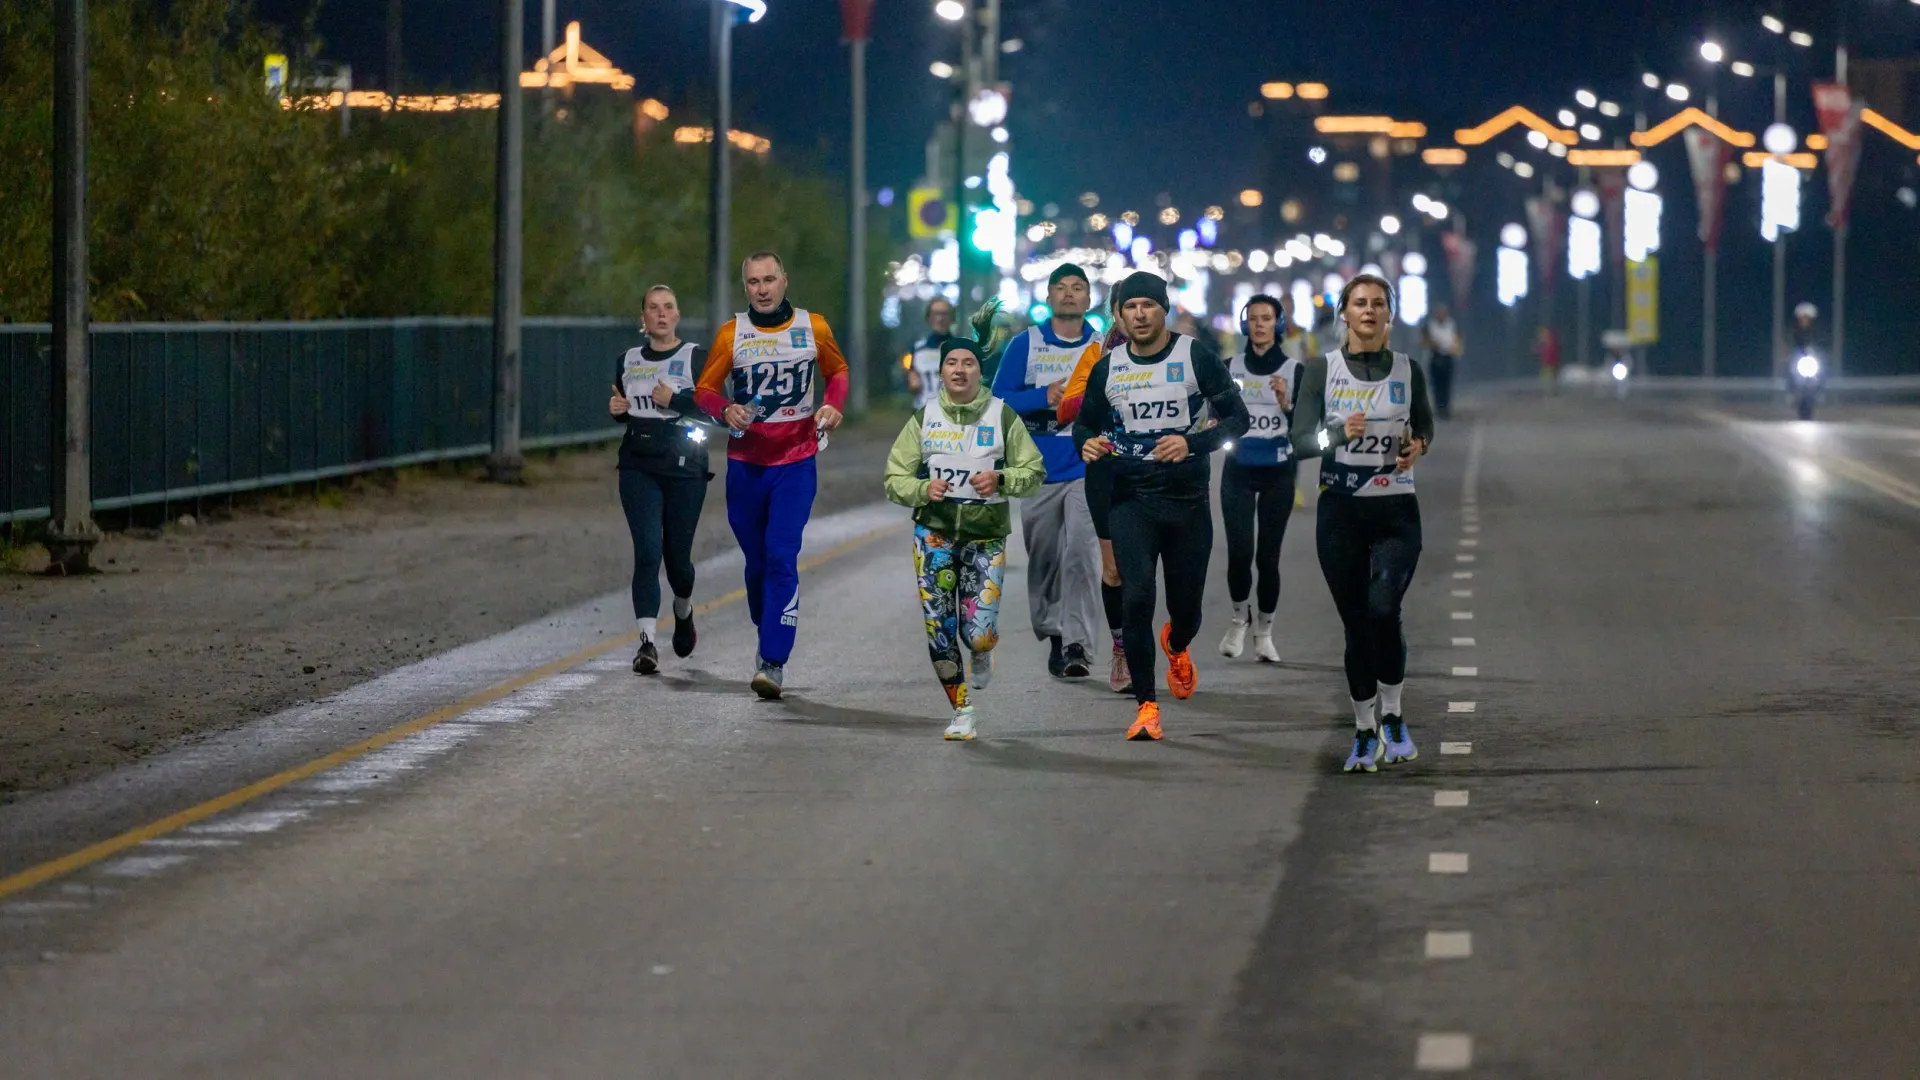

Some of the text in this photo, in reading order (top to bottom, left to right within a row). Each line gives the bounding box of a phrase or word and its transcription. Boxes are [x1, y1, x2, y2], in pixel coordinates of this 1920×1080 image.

[739, 347, 780, 358] ЯМАЛ
[1034, 364, 1073, 373] ЯМАЛ
[743, 362, 810, 396] 1251
[634, 396, 656, 409] 111
[1331, 400, 1375, 412] ЯМАЛ
[1128, 400, 1180, 419] 1275
[1249, 415, 1281, 430] 209
[923, 440, 964, 452] ЯМАЛ
[934, 467, 982, 488] 127
